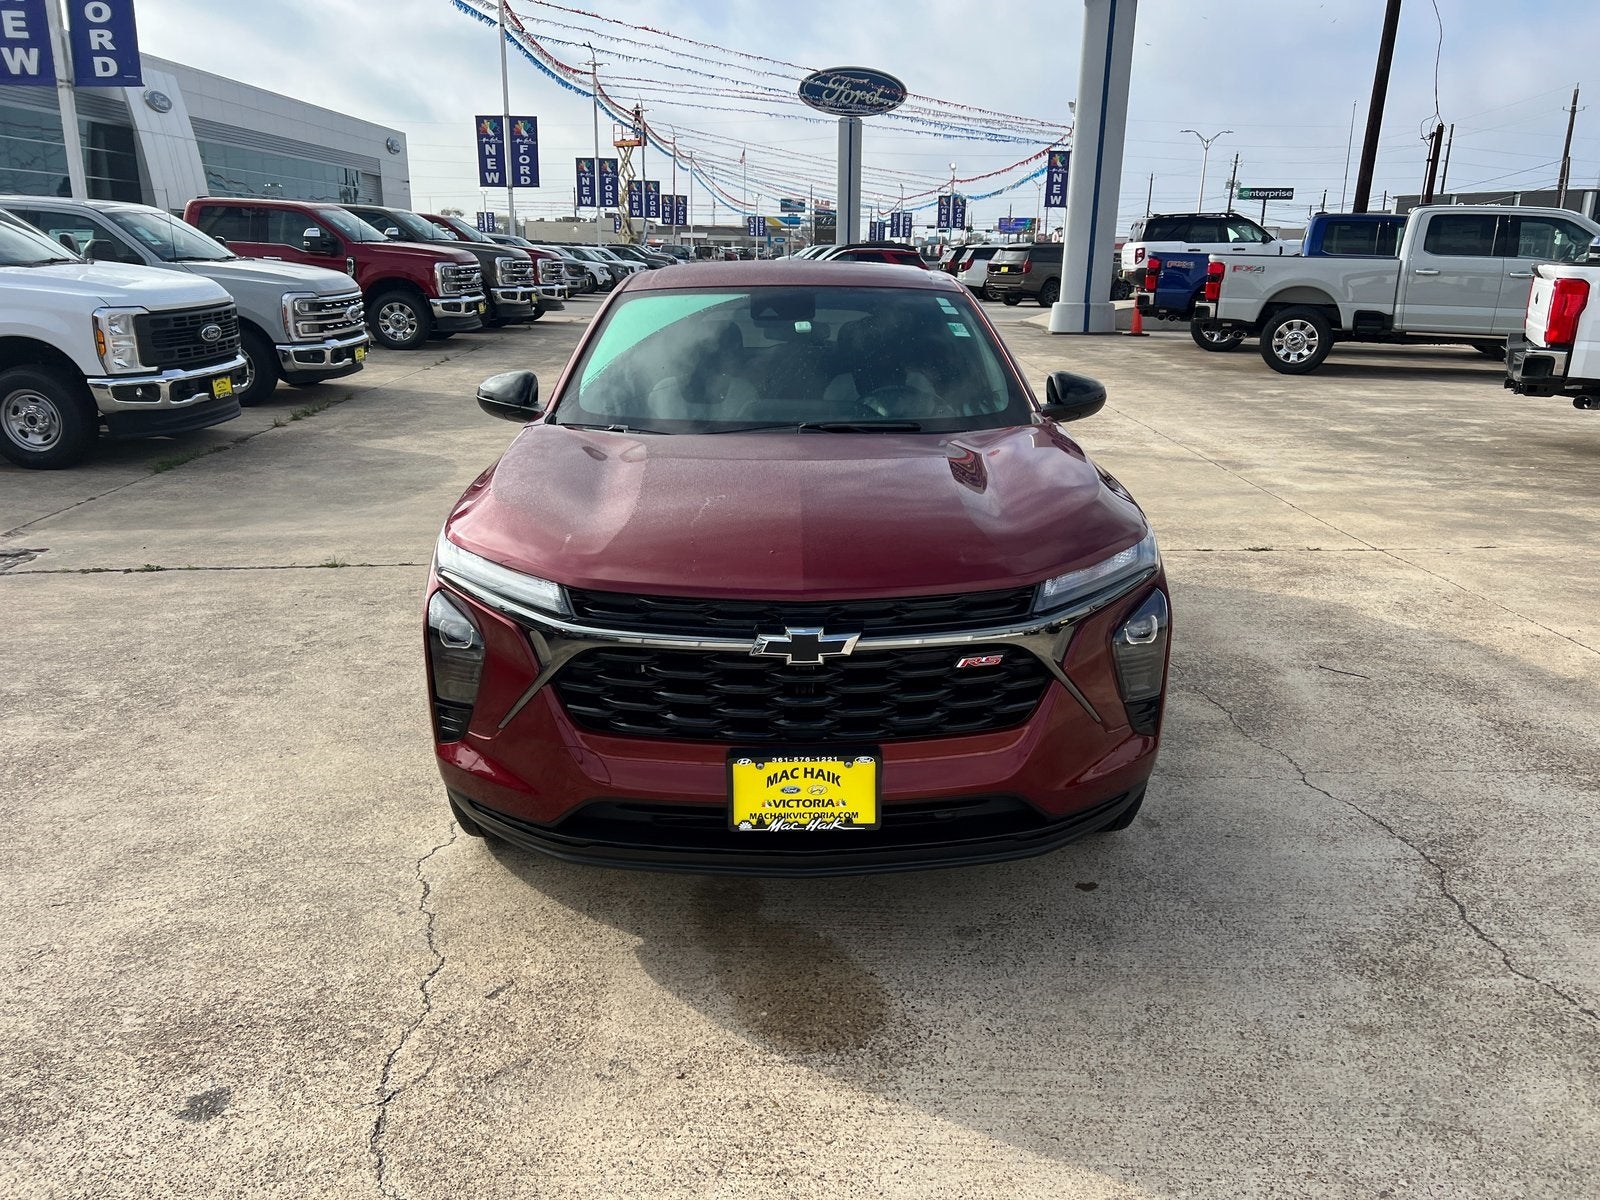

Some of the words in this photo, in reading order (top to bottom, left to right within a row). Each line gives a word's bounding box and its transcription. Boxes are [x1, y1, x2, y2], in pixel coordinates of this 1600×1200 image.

[0, 0, 39, 75] EW
[84, 1, 117, 77] ORD
[822, 76, 881, 105] Ford
[485, 144, 500, 183] NEW
[519, 145, 531, 184] FORD
[581, 177, 591, 205] NEW
[605, 178, 614, 206] FORD
[1050, 173, 1062, 205] NEW
[1242, 189, 1293, 198] enterprise
[632, 195, 640, 216] NEW
[1232, 265, 1265, 273] FX4
[956, 655, 1004, 668] RS
[766, 767, 800, 788] MAC
[803, 767, 842, 788] HAIK
[772, 799, 836, 808] VICTORIA
[766, 817, 805, 832] Mac
[805, 817, 846, 832] Haik
